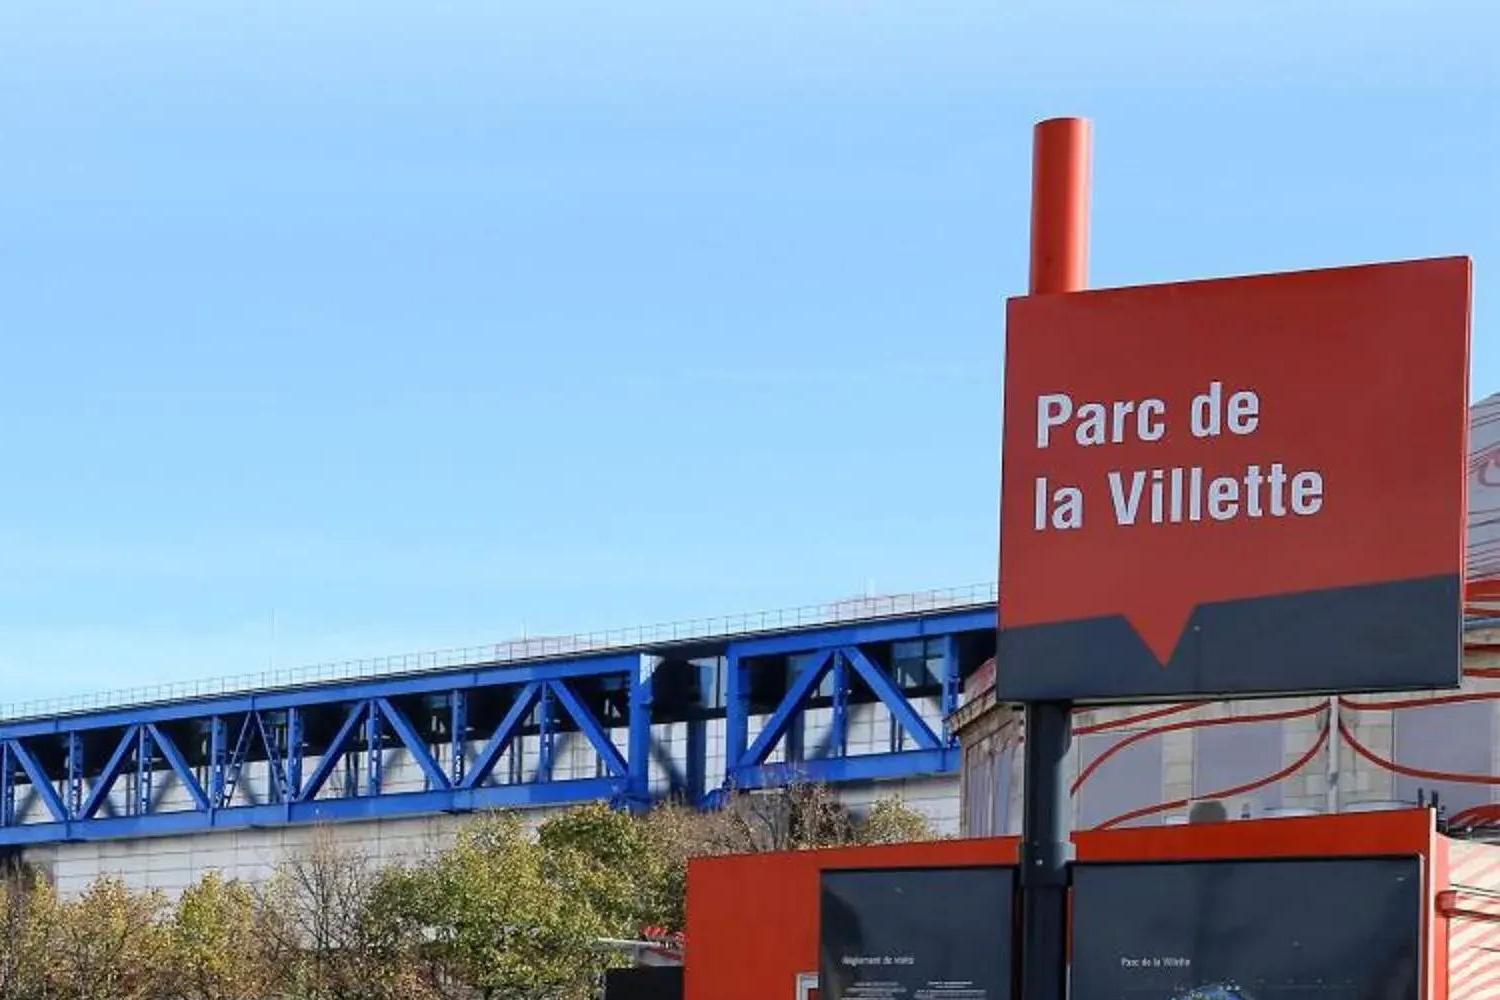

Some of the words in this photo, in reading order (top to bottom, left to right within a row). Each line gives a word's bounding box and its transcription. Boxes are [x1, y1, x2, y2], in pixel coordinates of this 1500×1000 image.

[1036, 393, 1166, 449] Parc
[1190, 381, 1260, 437] de
[1033, 477, 1084, 531] la
[1107, 463, 1324, 525] Villette
[1121, 957, 1139, 967] Parc
[1141, 957, 1151, 967] de
[1153, 957, 1161, 967] la
